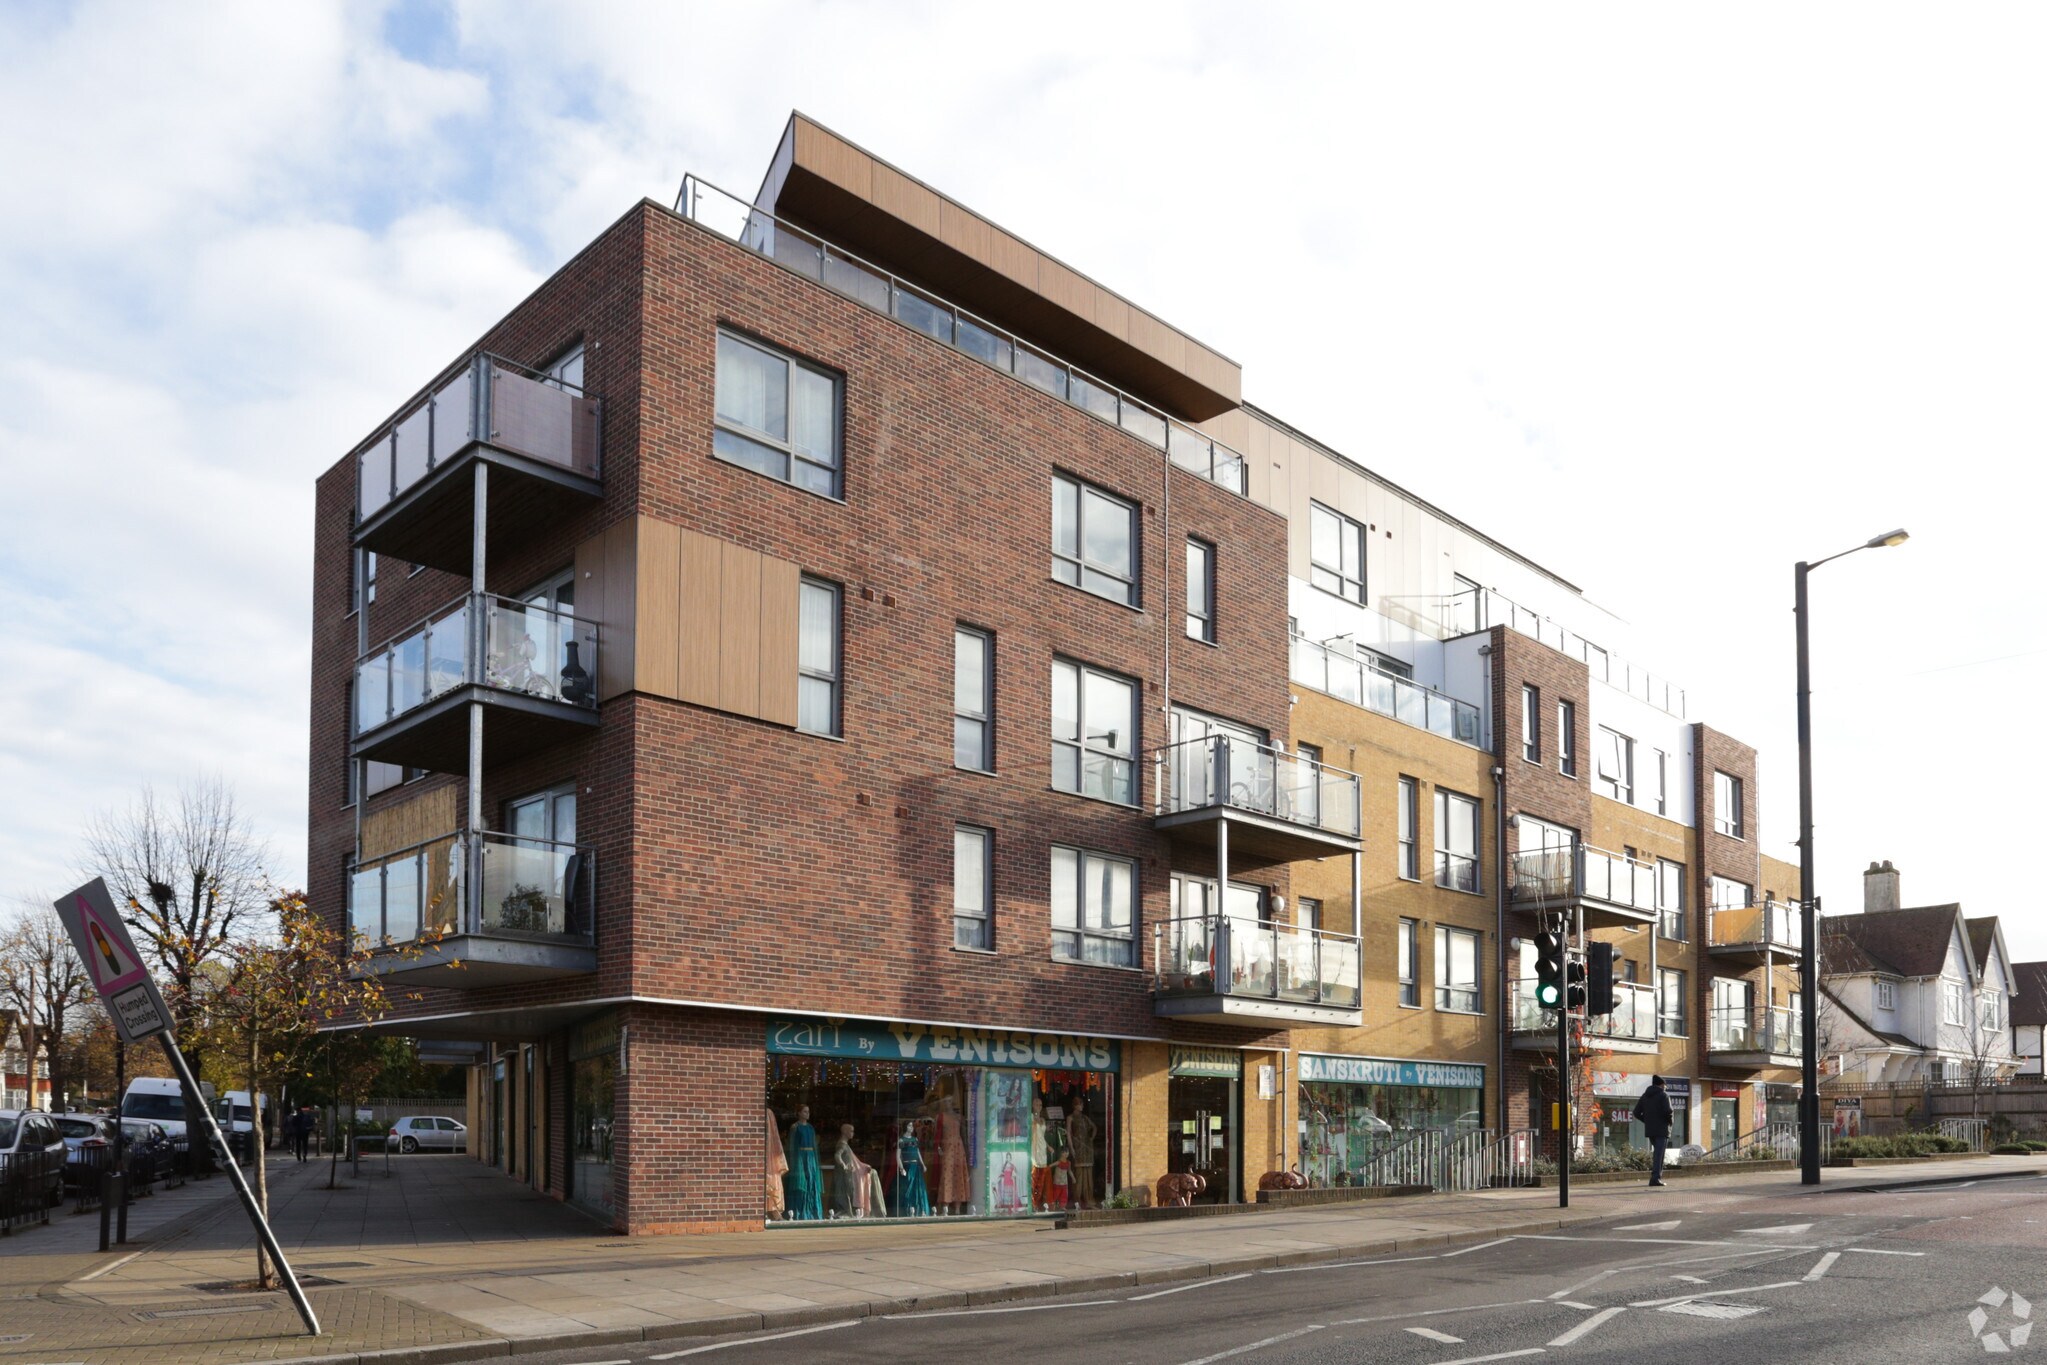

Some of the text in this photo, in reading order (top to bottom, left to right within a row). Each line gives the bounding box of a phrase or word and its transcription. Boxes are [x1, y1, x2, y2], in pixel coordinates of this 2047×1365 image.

[117, 992, 149, 1014] Humped
[125, 1009, 159, 1029] Crossing
[858, 1037, 875, 1054] By
[888, 1021, 1112, 1069] VENISONS
[1169, 1046, 1240, 1072] VENISONS
[1300, 1056, 1402, 1083] SANSKRUTI
[1415, 1064, 1483, 1087] VENISONS
[1611, 1110, 1633, 1123] SALE
